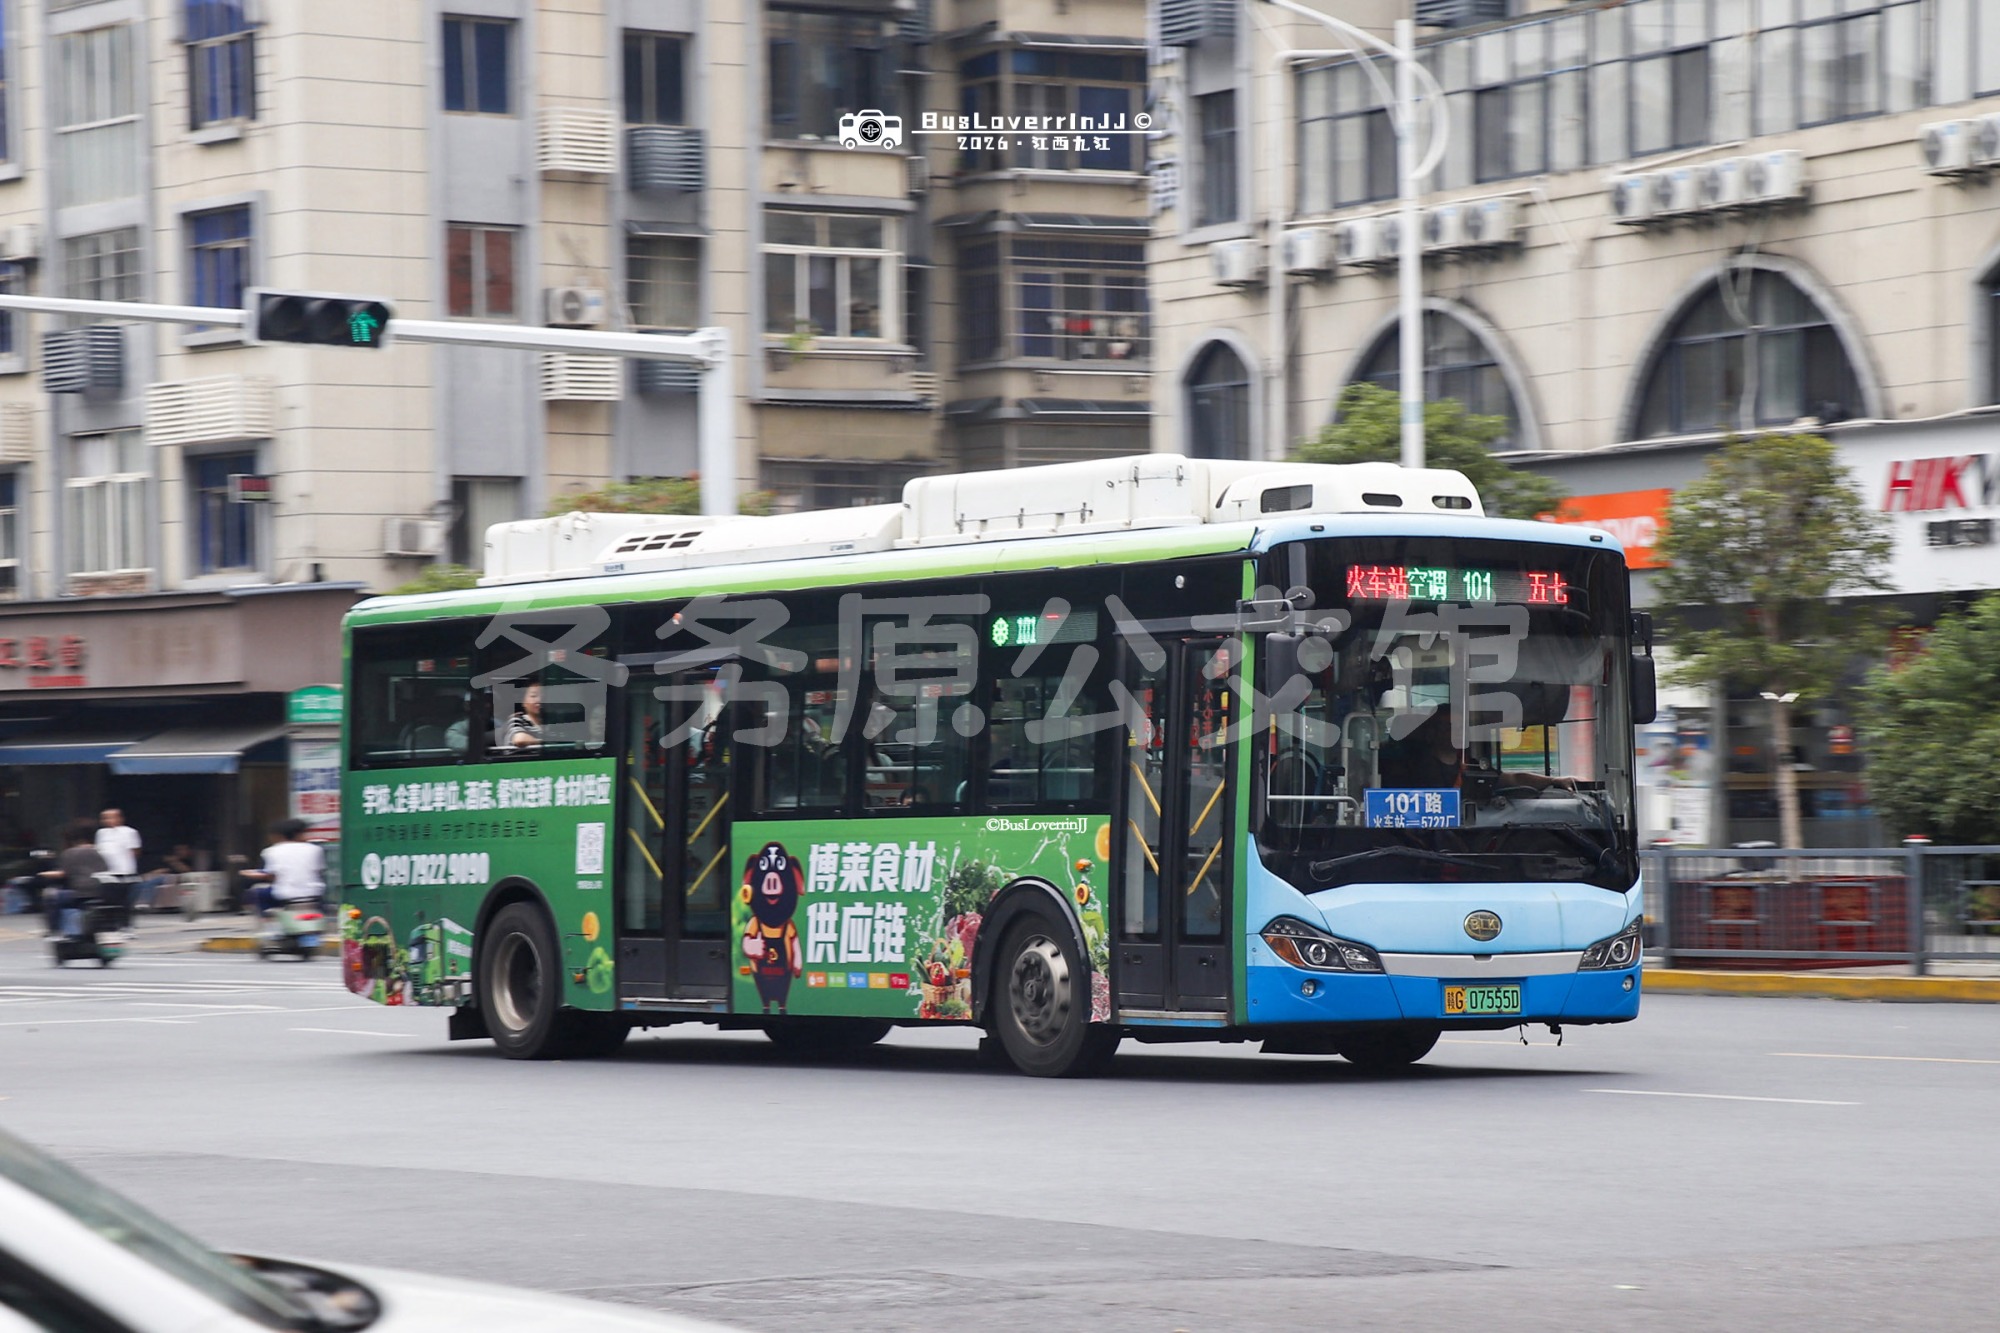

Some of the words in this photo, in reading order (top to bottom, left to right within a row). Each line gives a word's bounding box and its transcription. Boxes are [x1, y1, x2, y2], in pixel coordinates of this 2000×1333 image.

[1463, 571, 1491, 601] 101
[806, 901, 908, 964] 供应链
